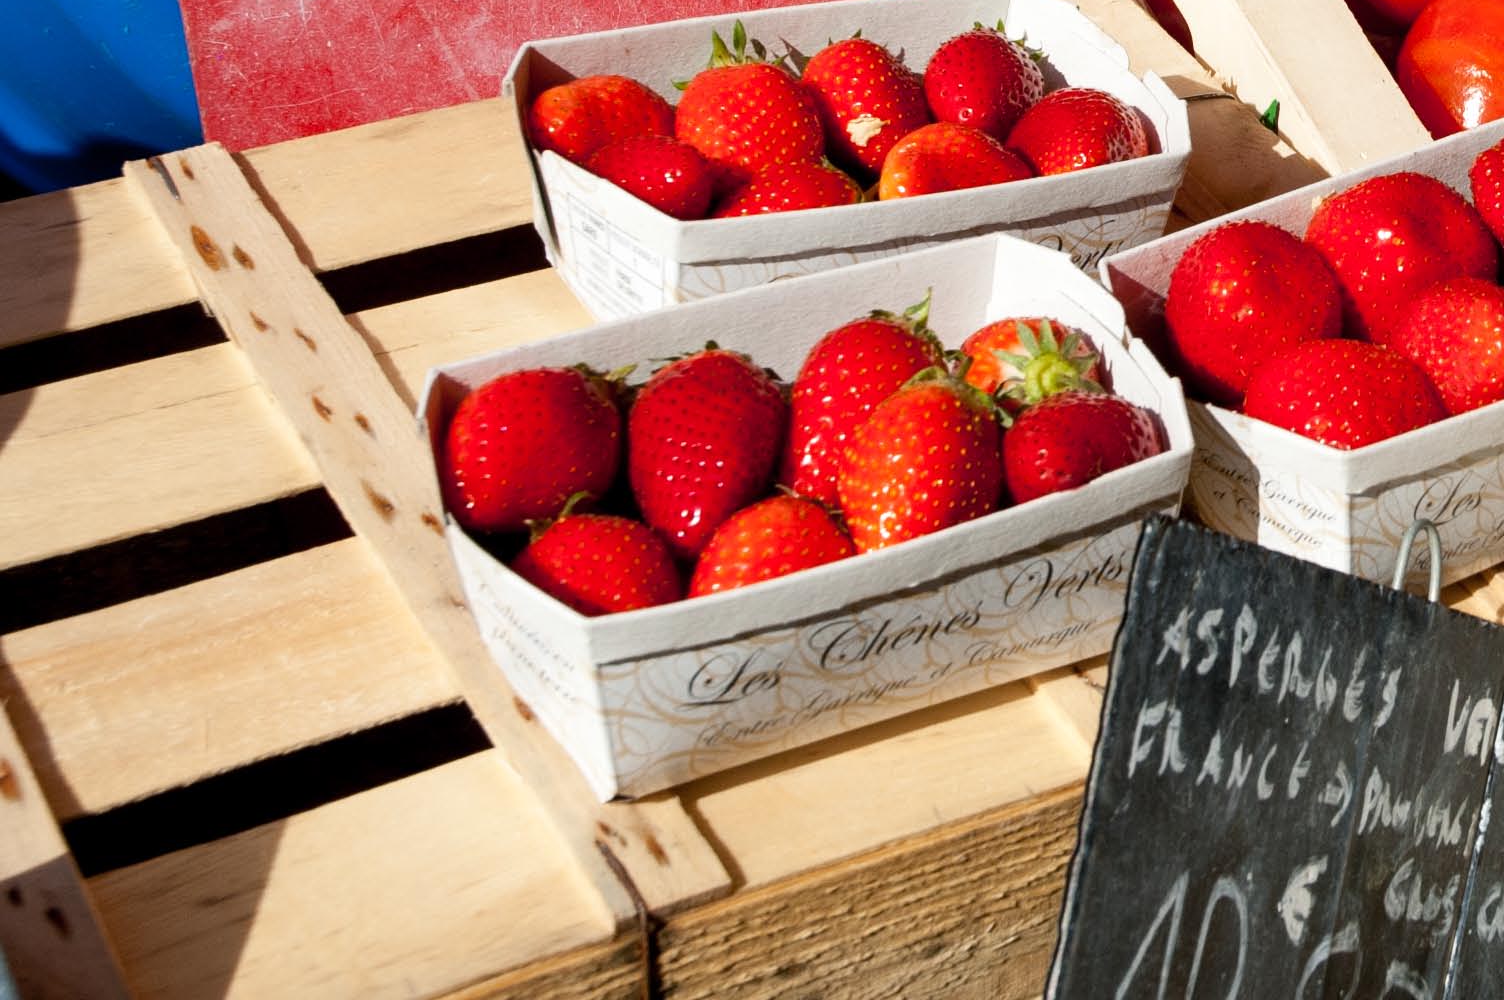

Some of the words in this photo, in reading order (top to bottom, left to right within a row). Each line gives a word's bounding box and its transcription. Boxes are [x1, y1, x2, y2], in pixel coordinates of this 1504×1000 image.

[678, 648, 782, 708] Les
[1003, 536, 1125, 613] Verts
[1128, 697, 1313, 800] FRANCE
